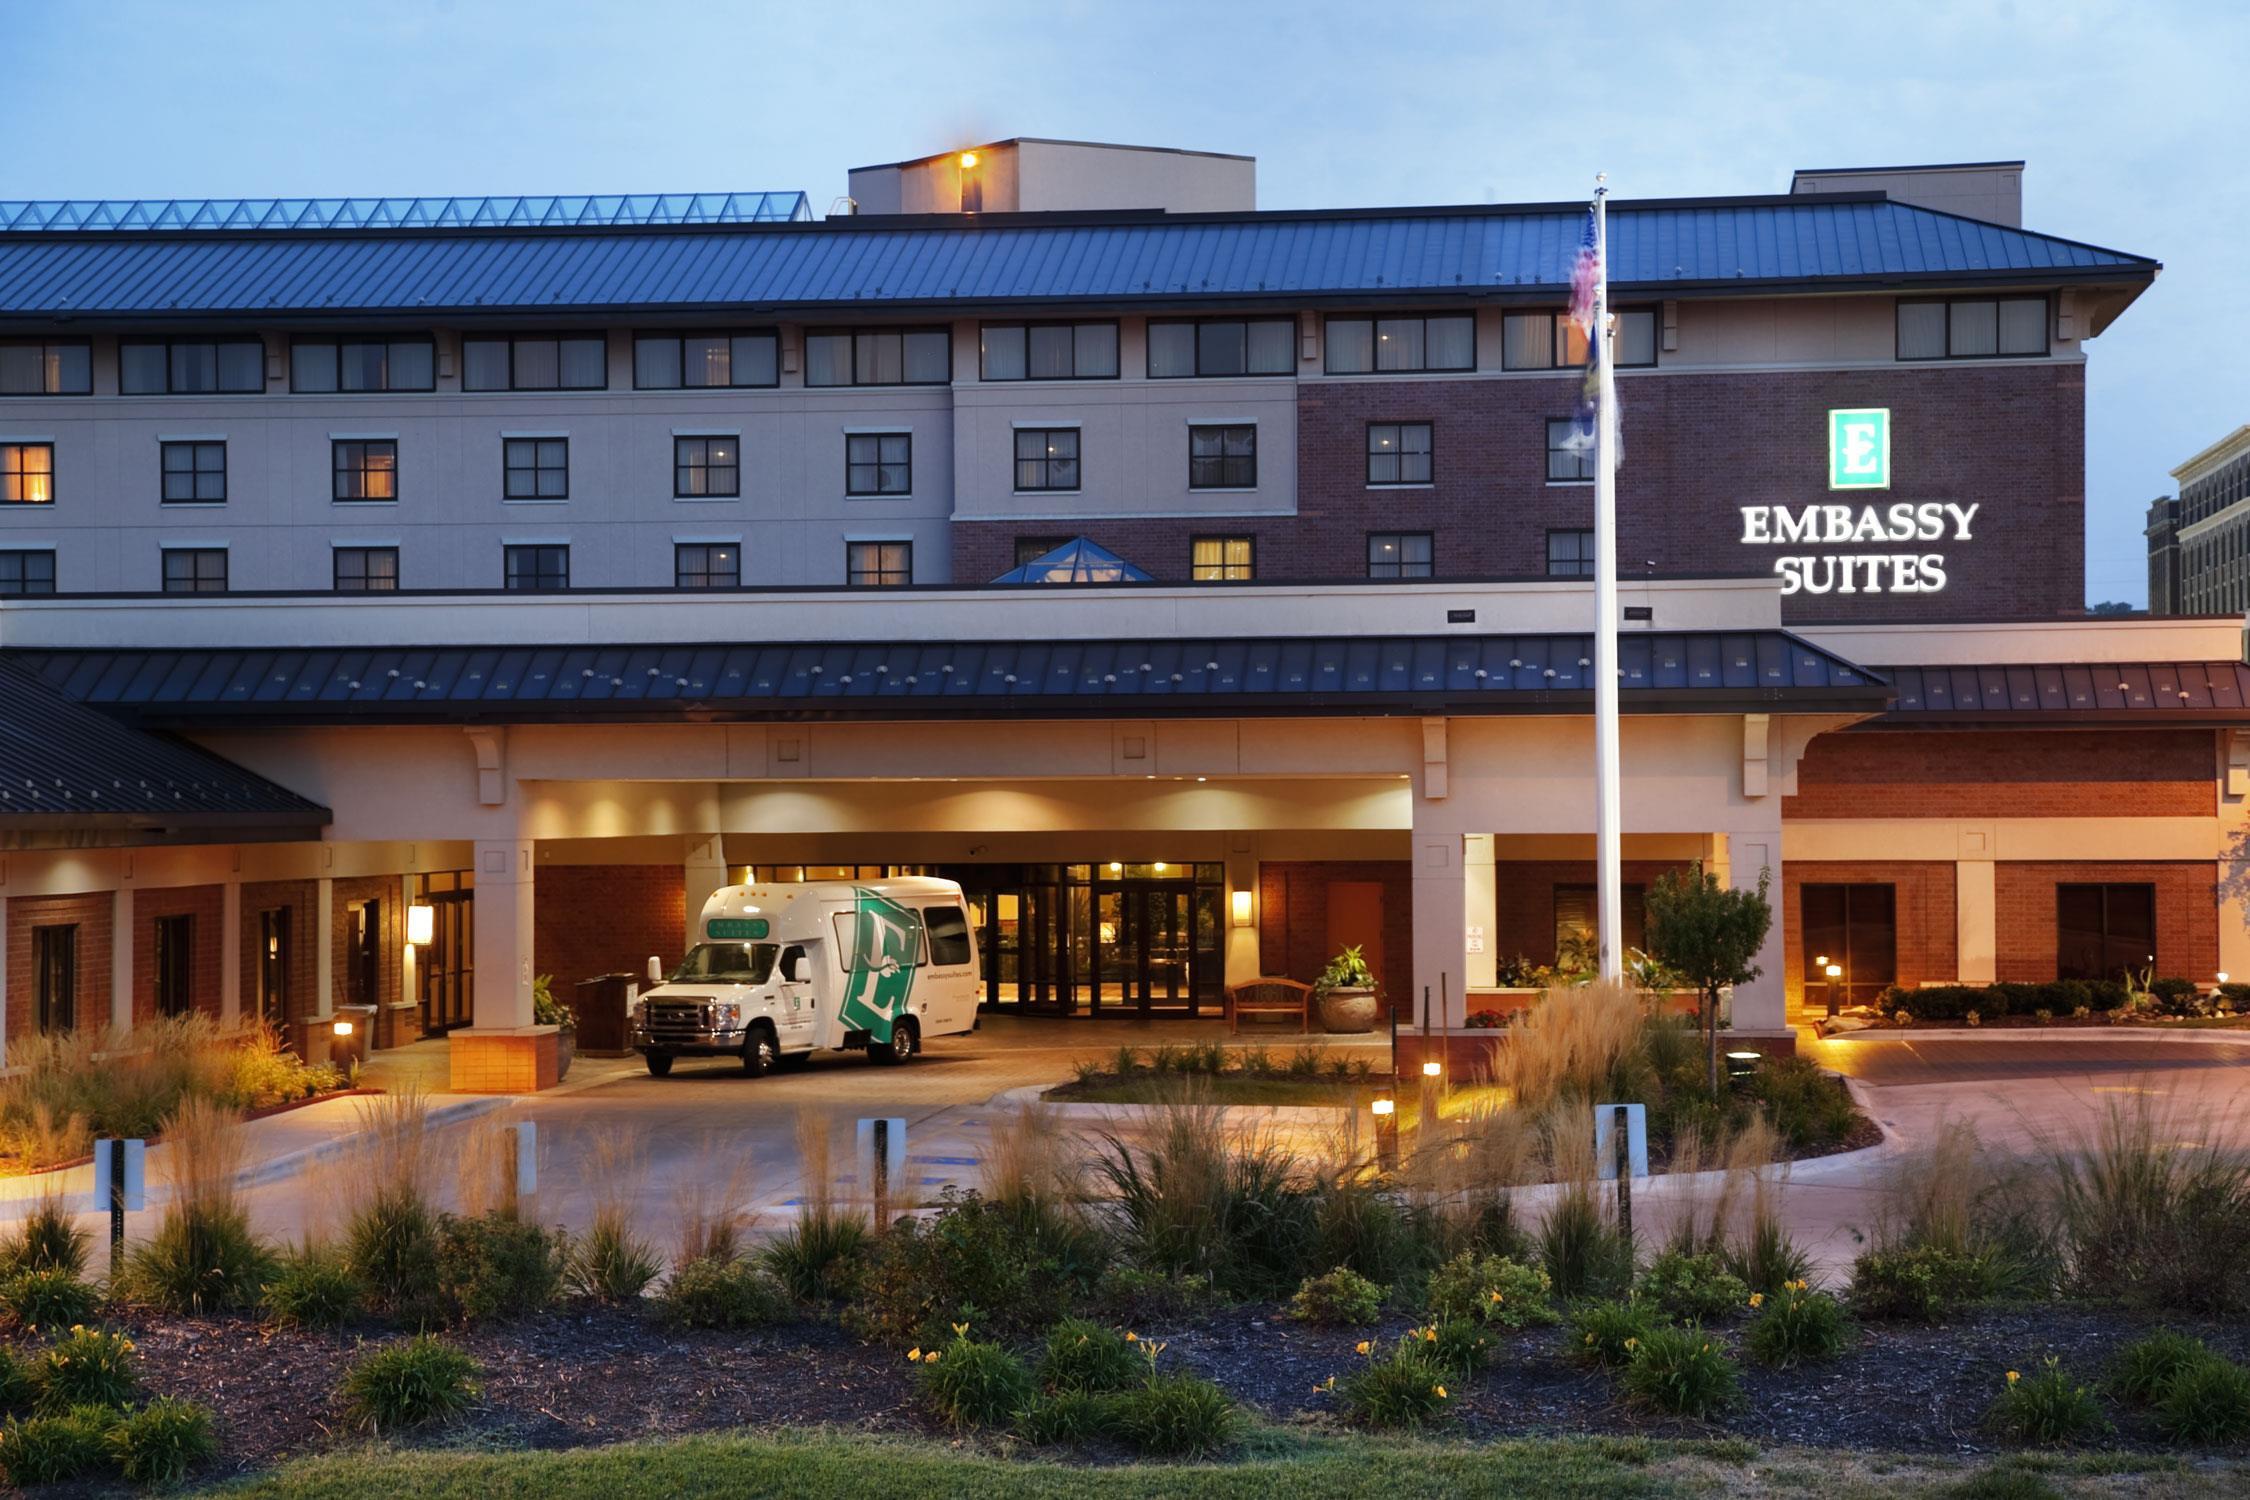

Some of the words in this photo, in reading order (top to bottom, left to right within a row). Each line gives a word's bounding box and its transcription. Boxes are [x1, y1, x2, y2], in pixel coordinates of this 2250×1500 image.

[1842, 423, 1877, 474] E
[1740, 503, 1979, 543] EMBASSY
[1774, 554, 1947, 594] SUITES
